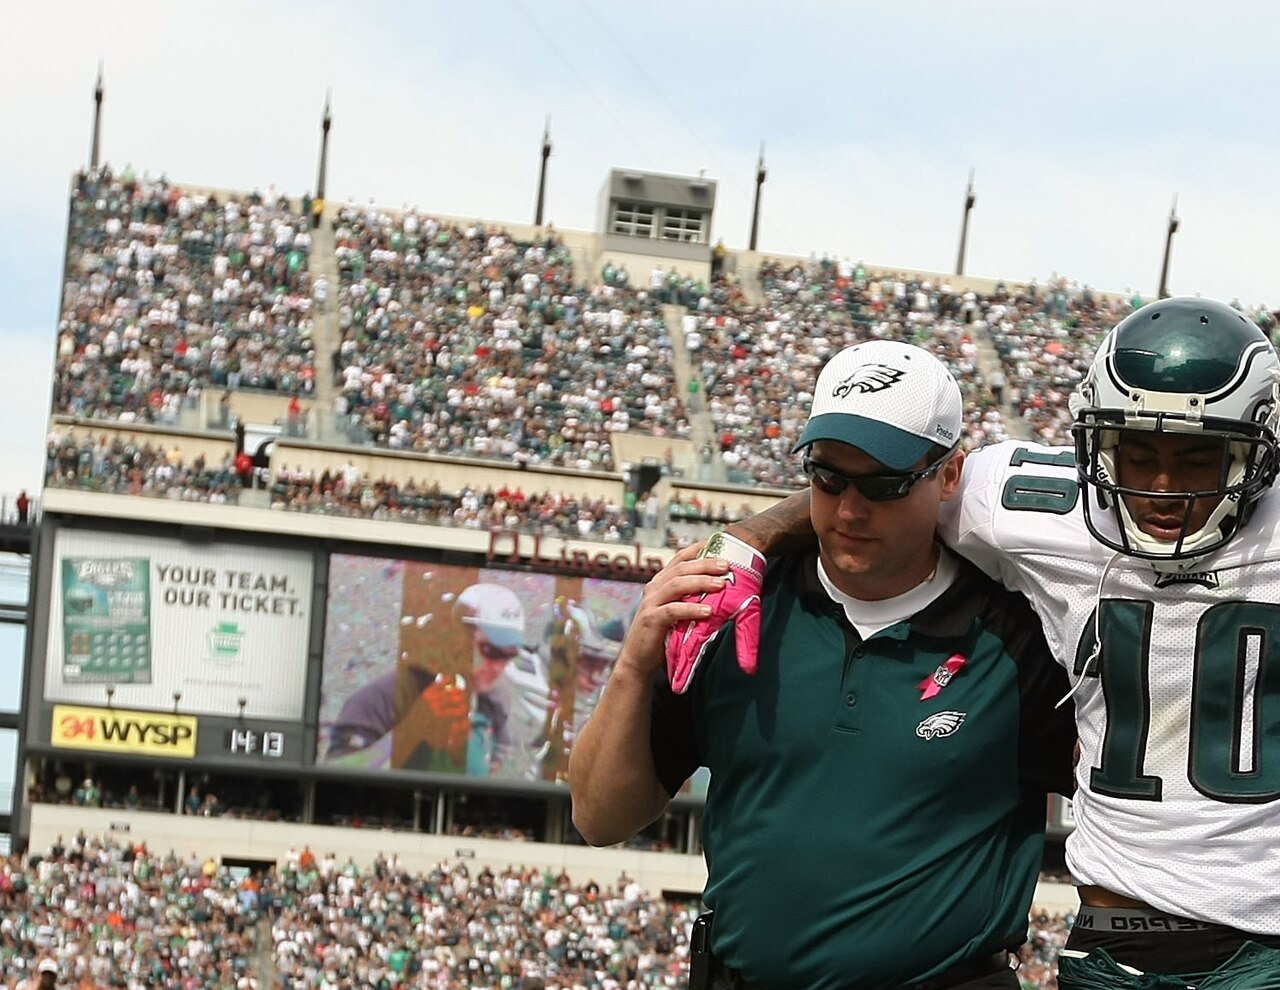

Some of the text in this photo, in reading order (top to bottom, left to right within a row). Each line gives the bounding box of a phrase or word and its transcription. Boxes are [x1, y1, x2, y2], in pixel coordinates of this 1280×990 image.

[1002, 447, 1079, 515] 10
[157, 565, 295, 594] YOUR TEAM.
[164, 588, 211, 608] OUR
[219, 592, 303, 617] TICKET.
[101, 719, 191, 746] WYSP
